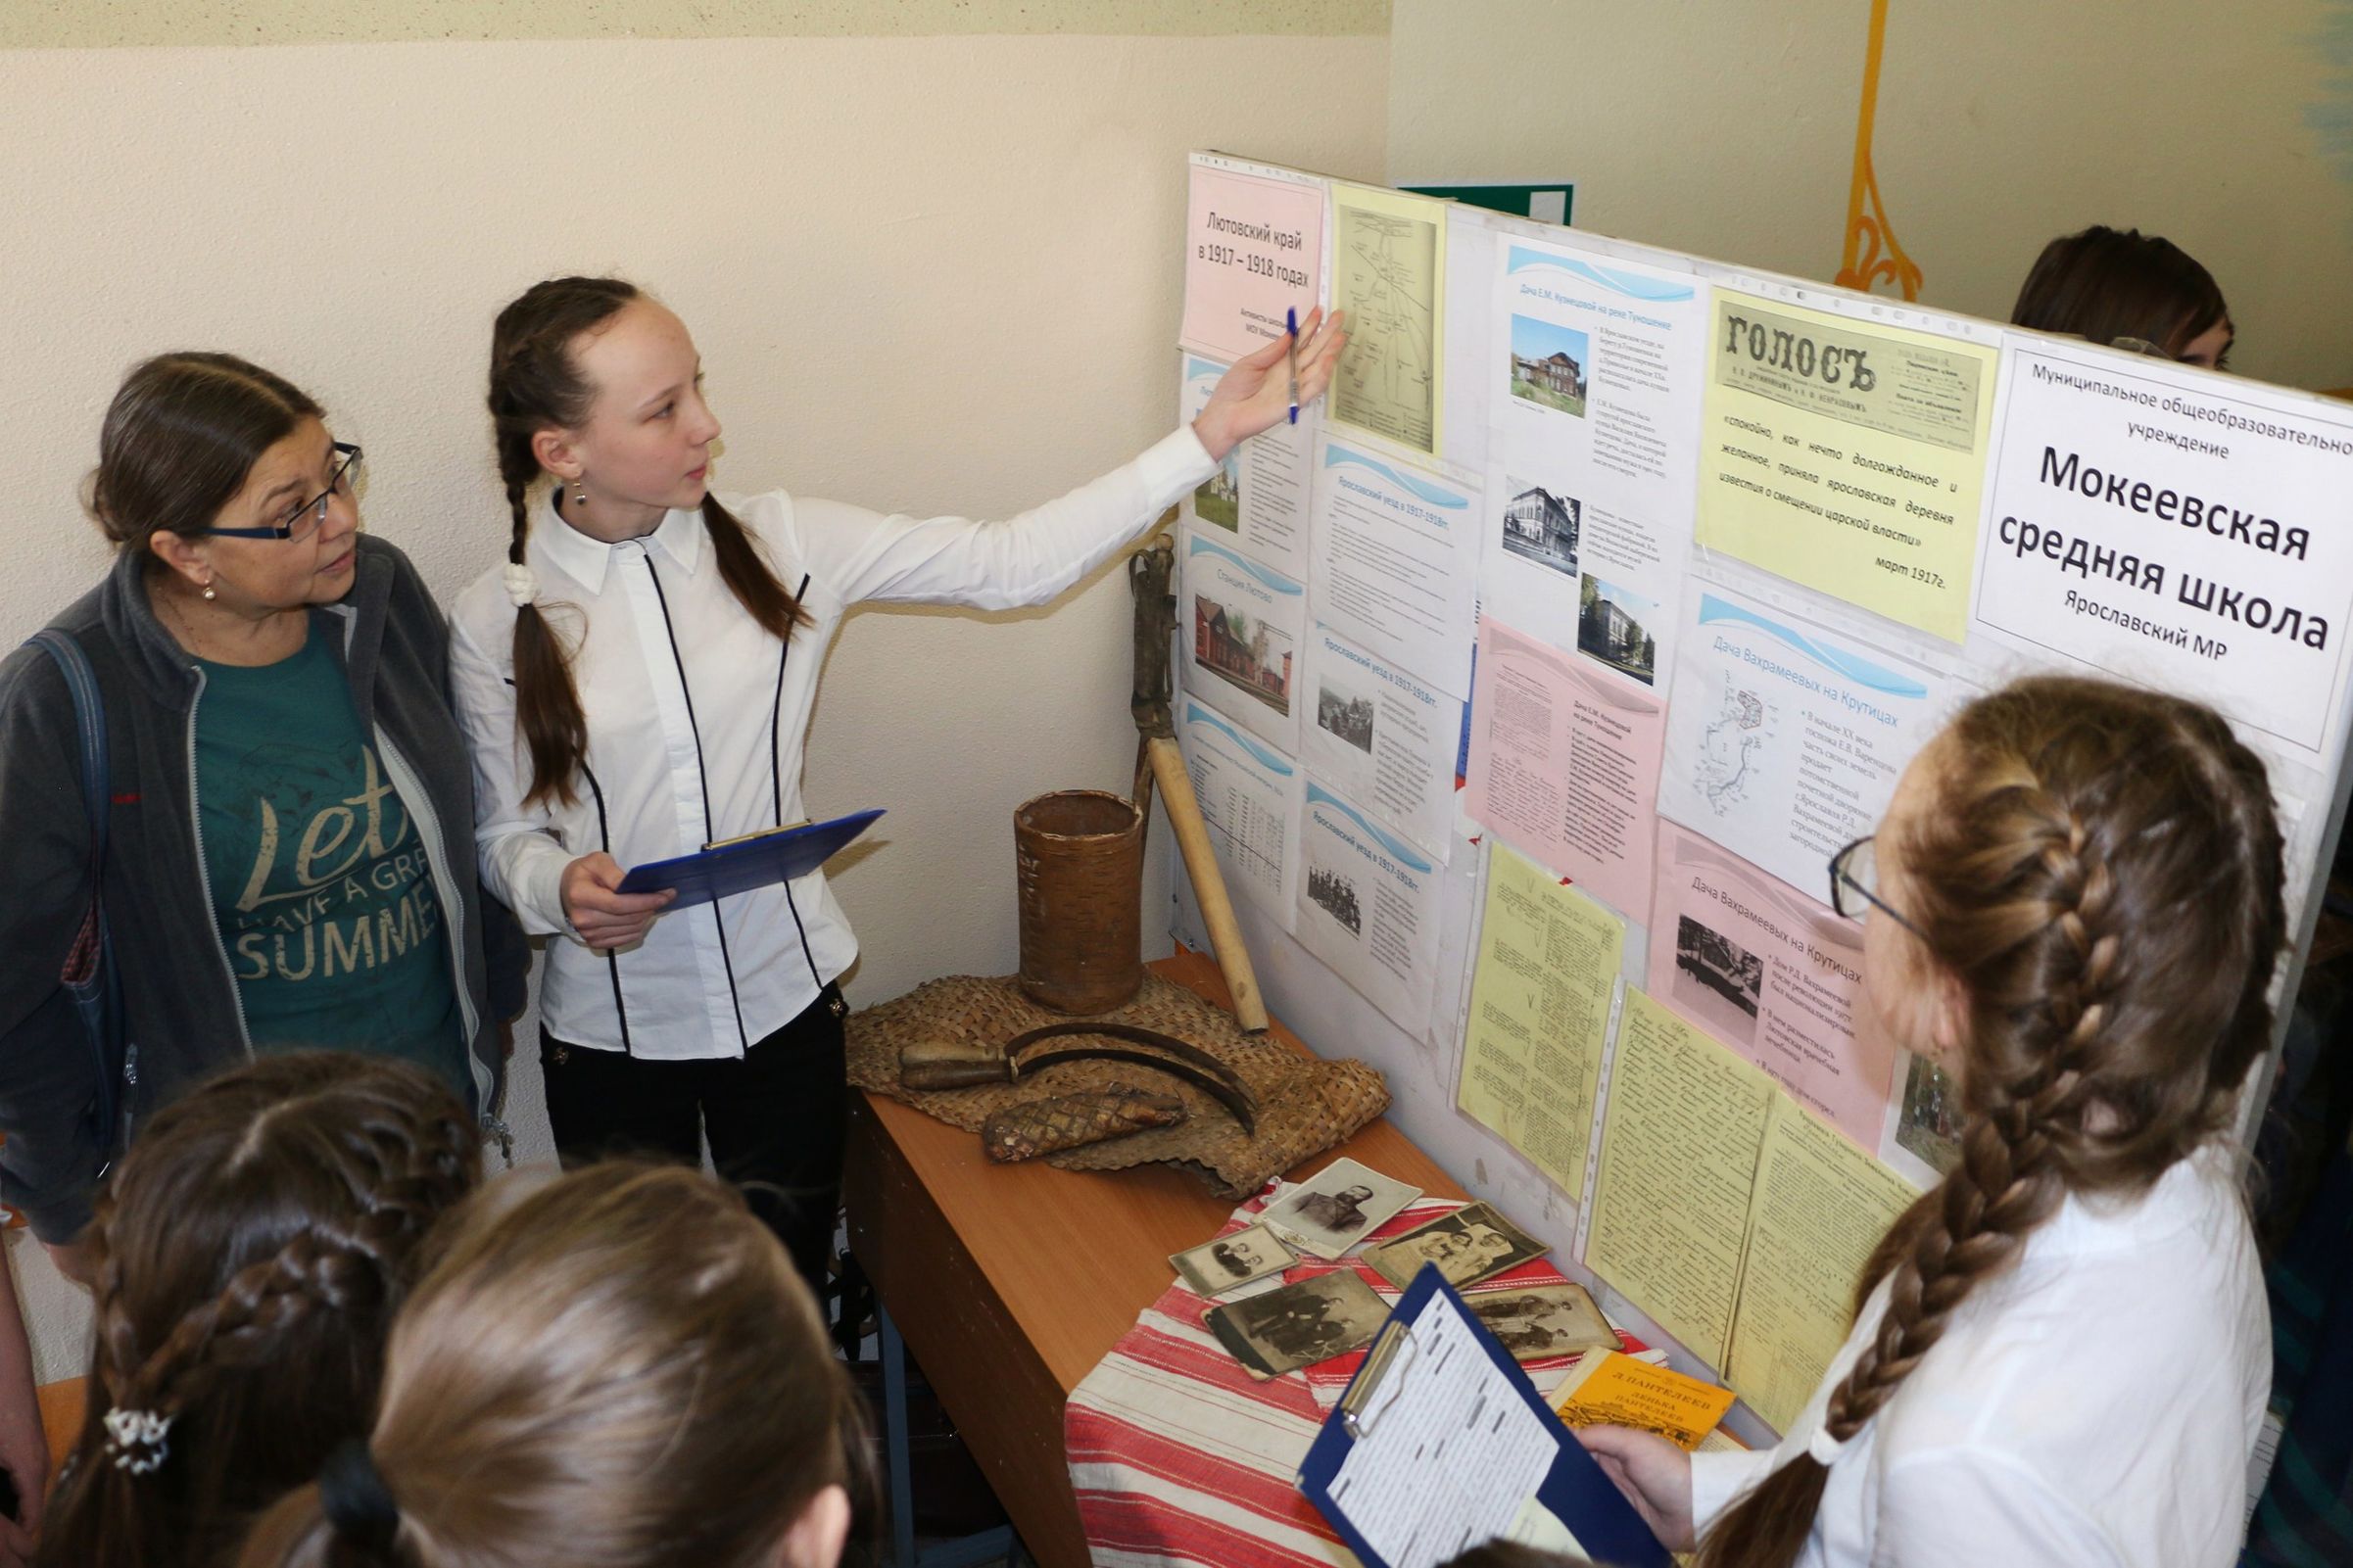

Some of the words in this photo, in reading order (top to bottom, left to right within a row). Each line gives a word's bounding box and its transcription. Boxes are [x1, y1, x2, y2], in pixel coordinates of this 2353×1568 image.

[1198, 245, 1205, 259] в
[1208, 244, 1234, 265] 1917
[1247, 254, 1273, 277] 1918
[1276, 265, 1309, 288] годах
[1207, 212, 1271, 243] Лютовский
[1273, 230, 1302, 251] край
[1726, 314, 1877, 392] ГОЛОСЪ
[2032, 363, 2157, 408] Муниципальное
[2161, 395, 2353, 456] общеобразовательно
[2128, 419, 2231, 460] учреждение
[1720, 444, 1771, 469] желанное,
[1778, 461, 1819, 485] приняла
[1826, 478, 1897, 508] ярославская
[1905, 499, 1954, 526] деревня
[1724, 414, 1774, 440] «спокойно,
[1782, 434, 1800, 448] как
[1808, 441, 1843, 460] нечто
[1852, 452, 1939, 488] долгожданное
[1950, 482, 1957, 493] и
[1719, 472, 1764, 496] известия
[1765, 488, 1772, 498] о
[1774, 489, 1823, 516] смещении
[1825, 507, 1870, 534] царской
[1872, 524, 1921, 548] власти»
[2040, 446, 2311, 561] Мокеевская
[1875, 555, 1908, 579] март
[1910, 565, 1946, 591] 1917г.
[1999, 515, 2165, 595] средняя
[2178, 572, 2329, 652] школа
[2064, 589, 2187, 646] Ярославский
[2193, 634, 2228, 662] МР
[1713, 636, 1741, 658] Дача
[1743, 647, 1820, 693] Вахрамеевых
[1823, 686, 1838, 700] на
[1841, 689, 1897, 729] Крутицах
[345, 877, 369, 903] A
[236, 883, 438, 981] SUMME
[1692, 877, 1717, 900] Дача
[1720, 891, 1789, 944] Вахрамеевых
[1791, 937, 1803, 953] на
[1806, 943, 1862, 985] Крутицах
[1626, 1376, 1711, 1410] ПАНТЕЛЕЕВ
